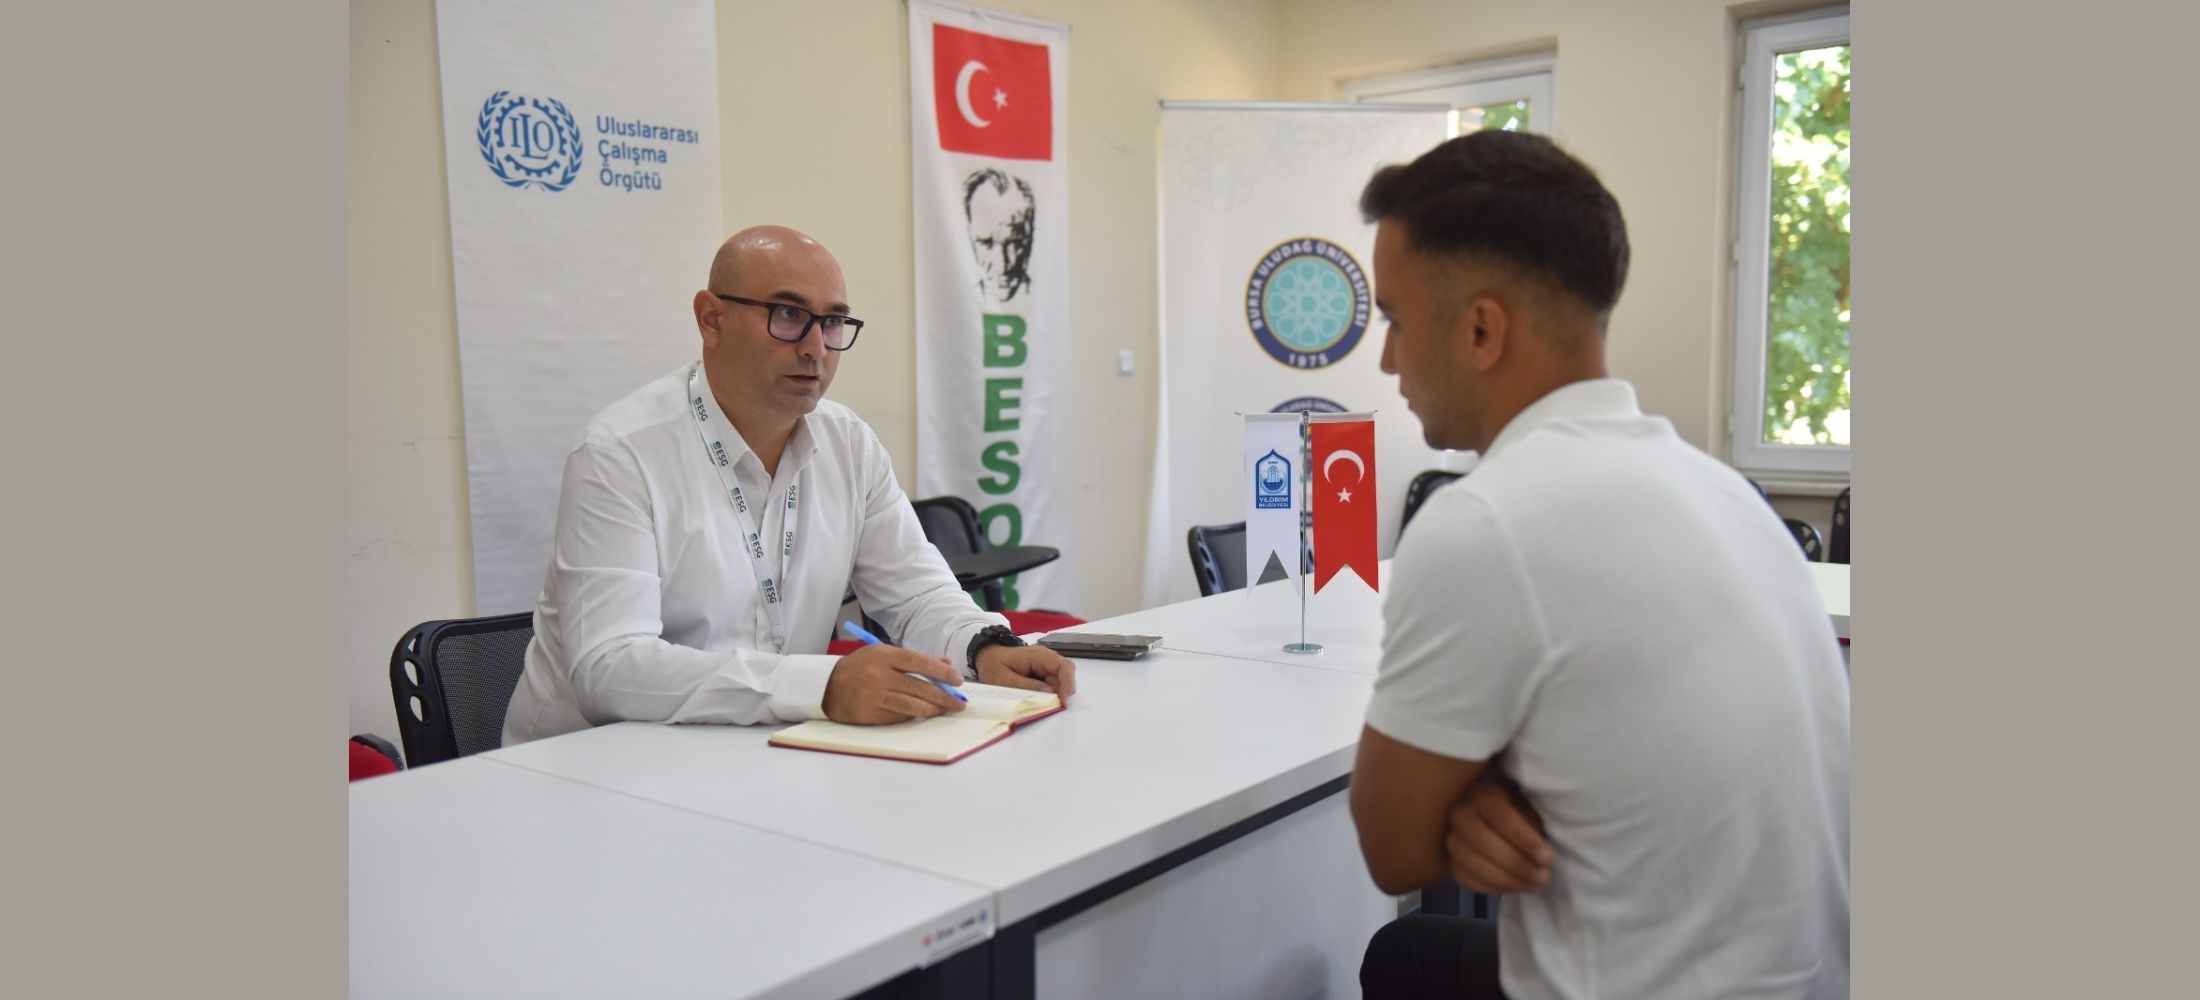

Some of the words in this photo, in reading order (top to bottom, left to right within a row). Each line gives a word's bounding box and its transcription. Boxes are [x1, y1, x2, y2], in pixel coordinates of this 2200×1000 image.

[509, 113, 554, 160] ILO
[596, 114, 699, 144] Uluslararası
[597, 139, 668, 166] Çalışma
[599, 160, 662, 192] Örgütü
[1248, 279, 1263, 330] BURSA
[1288, 353, 1329, 367] 1975
[697, 404, 708, 422] ESG
[715, 449, 728, 467] ESG
[971, 313, 1028, 610] BESO
[735, 495, 747, 513] ESG
[752, 540, 764, 559] ESG
[766, 586, 777, 604] ESG
